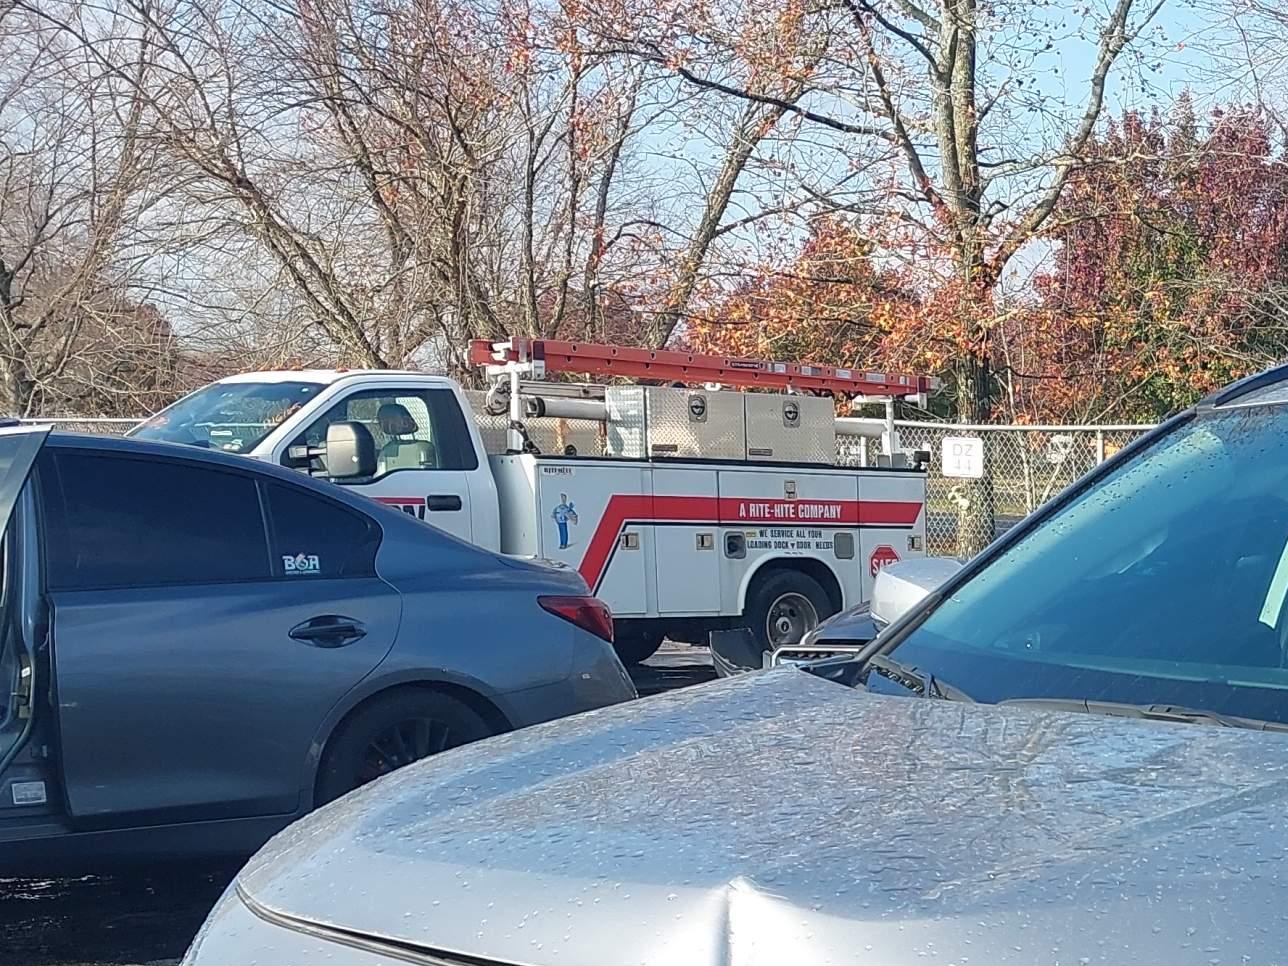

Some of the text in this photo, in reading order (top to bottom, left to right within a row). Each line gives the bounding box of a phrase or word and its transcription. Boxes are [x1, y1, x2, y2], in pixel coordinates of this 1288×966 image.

[739, 503, 842, 519] A RITE-HITE COMPANY
[759, 529, 768, 538] WE
[770, 529, 794, 539] SERVICE
[796, 530, 806, 539] ALL
[808, 530, 823, 539] YOUR
[747, 540, 834, 550] LOADING DOCK DOOR NEEDS
